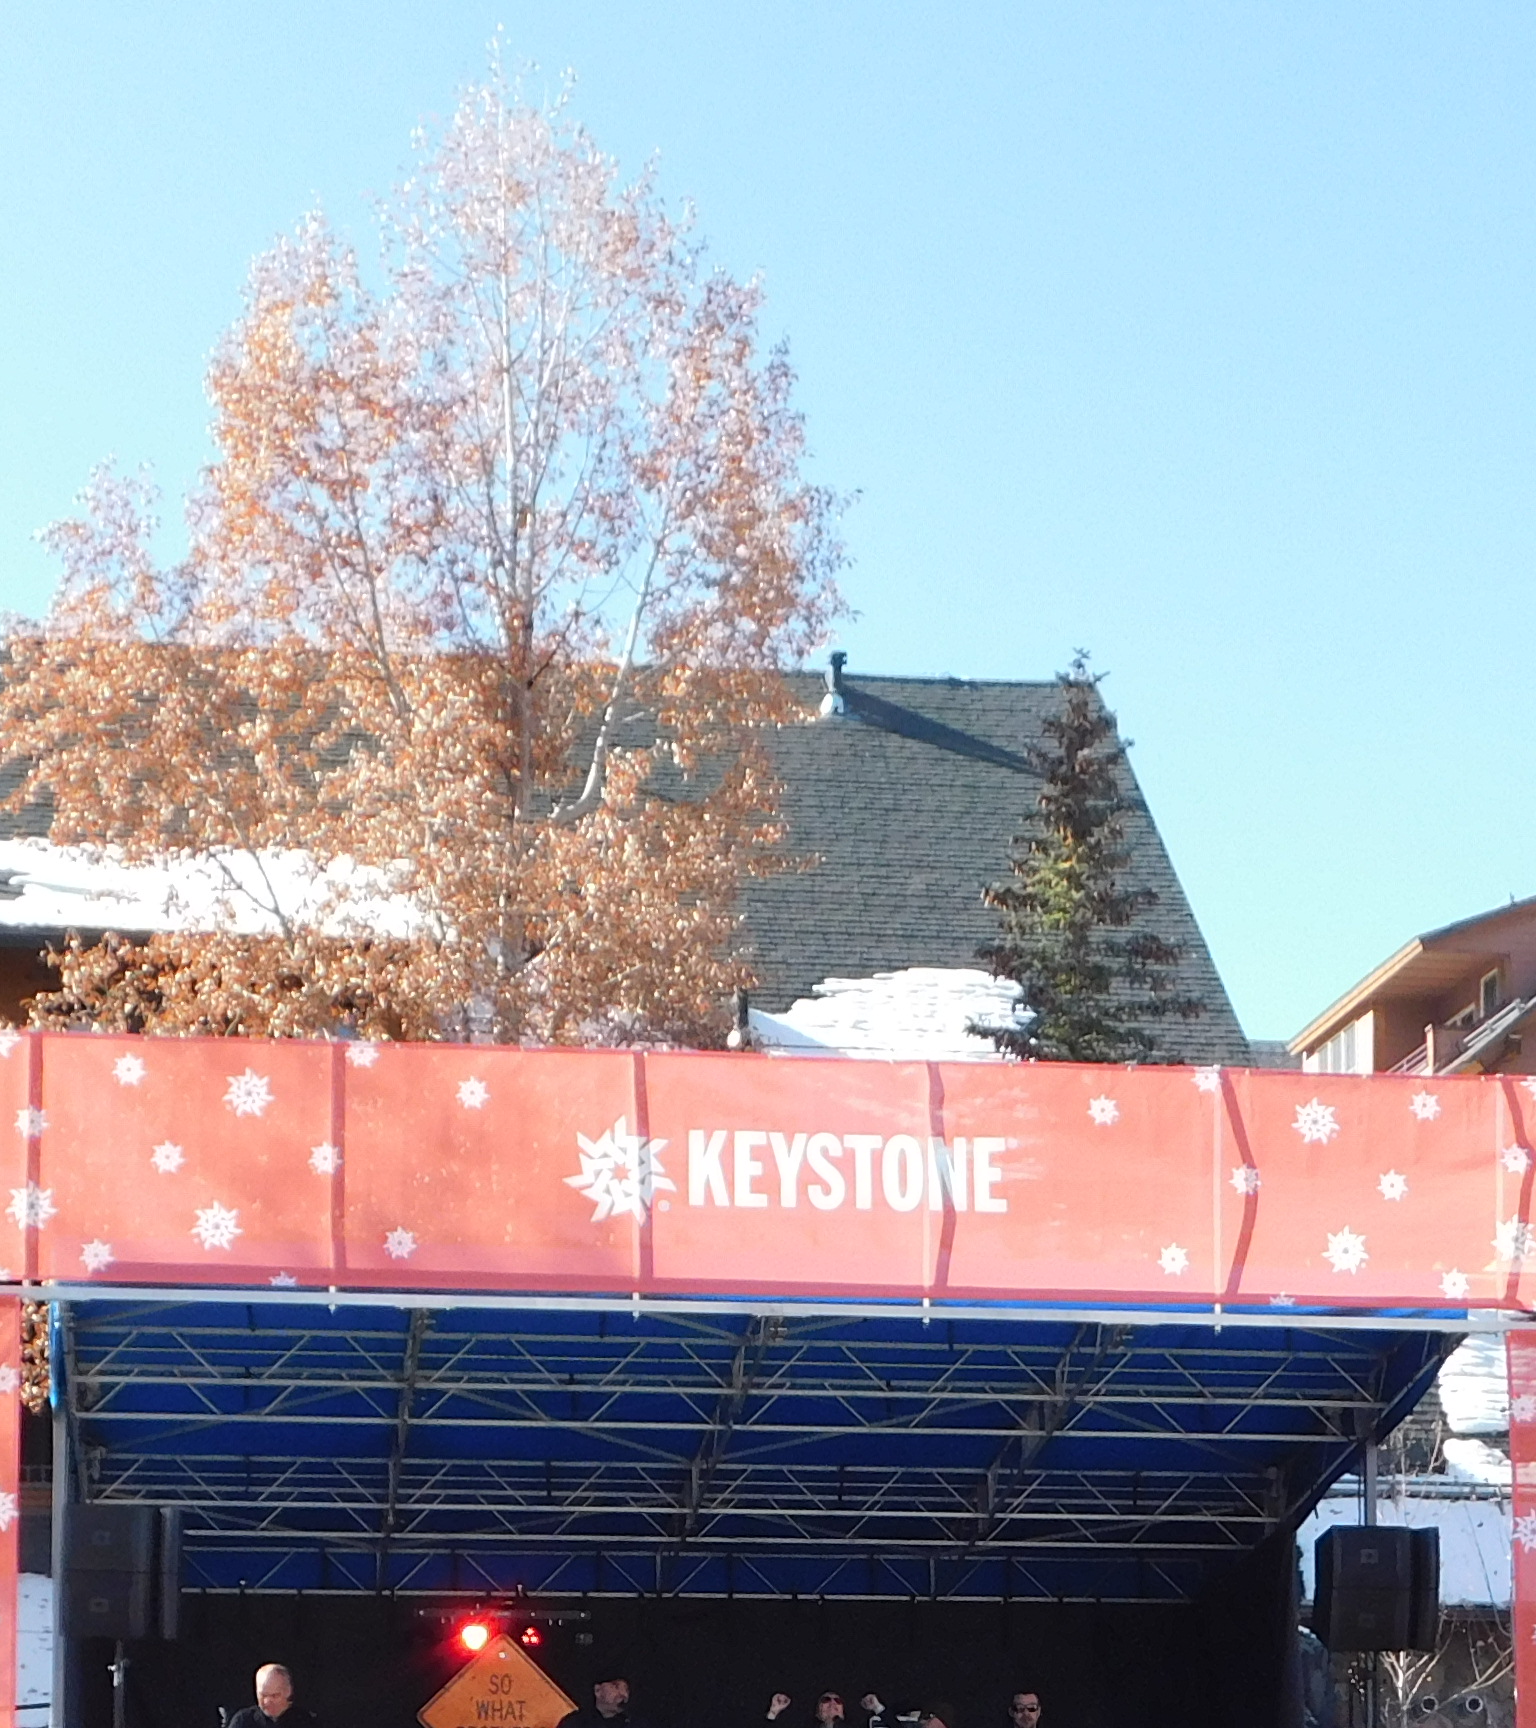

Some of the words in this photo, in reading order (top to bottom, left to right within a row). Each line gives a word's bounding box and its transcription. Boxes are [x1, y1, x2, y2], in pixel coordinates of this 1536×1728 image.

[688, 1129, 1008, 1213] KEYSTONE
[488, 1673, 513, 1696] SO
[475, 1700, 526, 1722] WHAT
